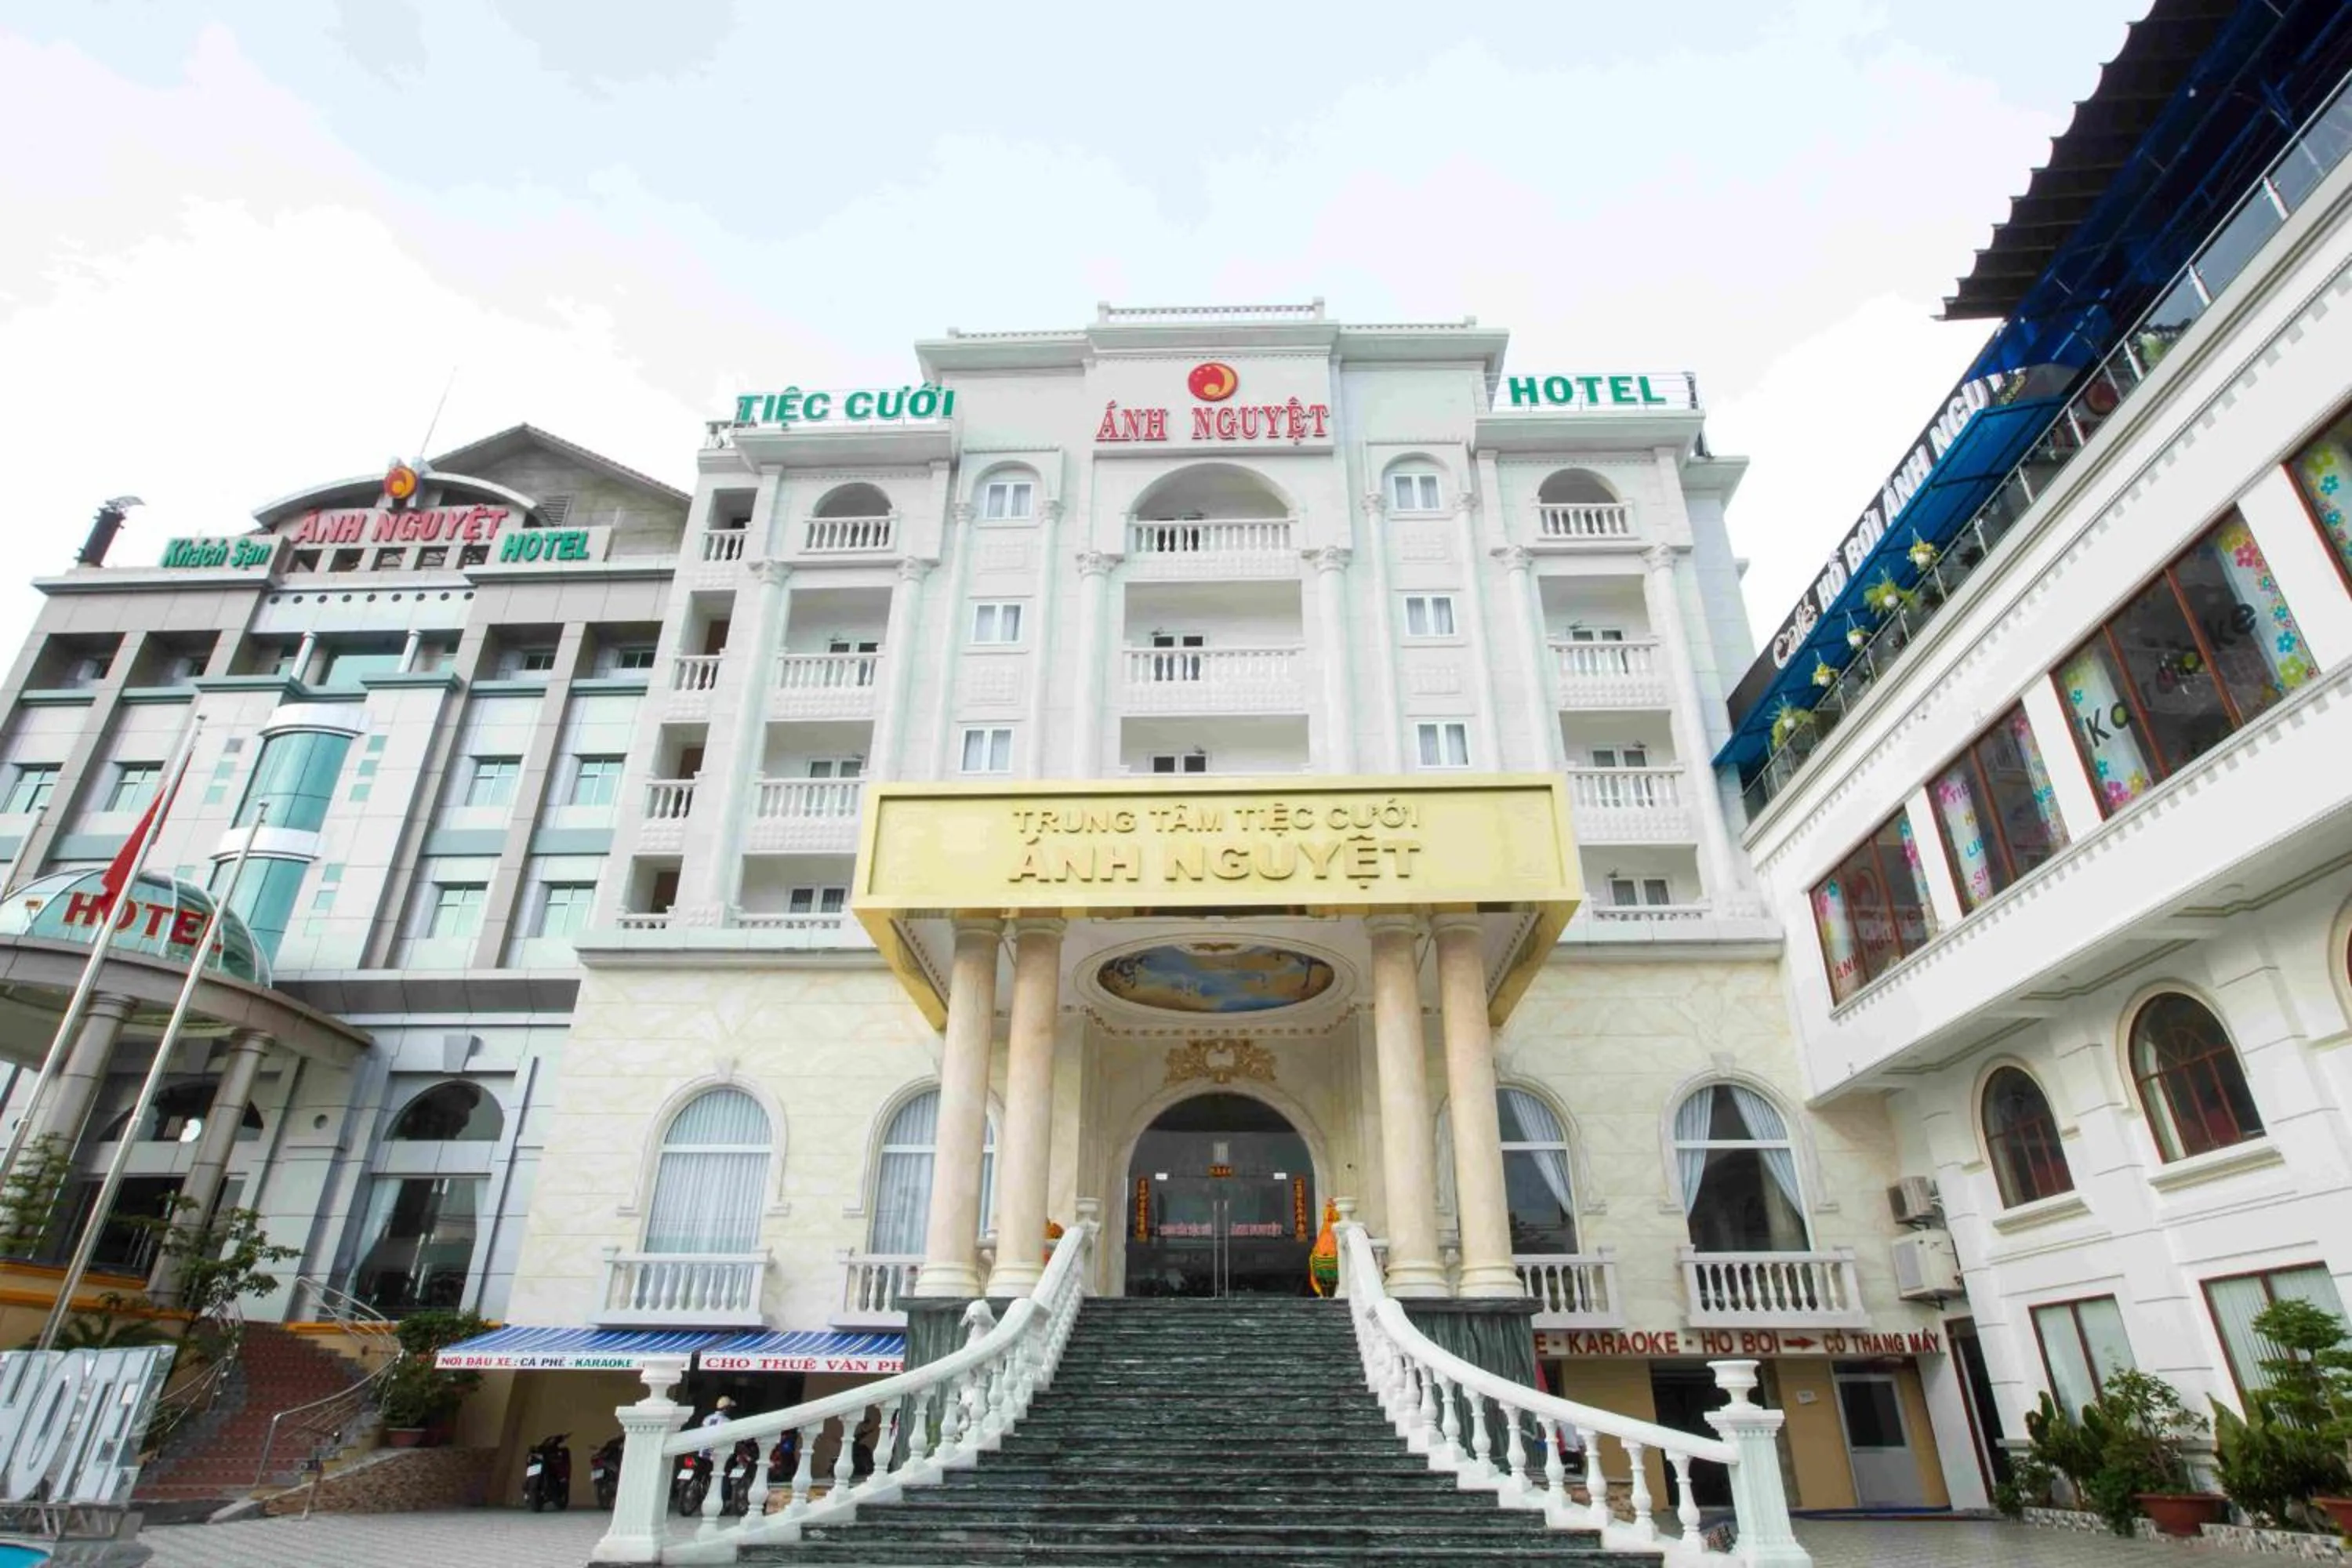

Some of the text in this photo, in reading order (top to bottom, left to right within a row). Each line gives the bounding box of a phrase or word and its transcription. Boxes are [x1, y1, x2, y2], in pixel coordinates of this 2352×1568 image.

[735, 382, 955, 430] TIỆC CƯỚI
[1508, 376, 1667, 406] HOTEL
[1095, 397, 1330, 445] ÁNH NGUYỆT
[293, 503, 510, 547] ÁNH NGUYỆT
[161, 537, 273, 570] Khách Sạn
[499, 529, 590, 563] HOTEL
[1013, 798, 1420, 837] TRUNG TÂM TIỆC CƯỚI
[1008, 835, 1421, 889] ÁNH NGUYỆT
[1569, 1330, 1679, 1355] KARAOKE
[575, 1358, 636, 1368] KARAOKE
[705, 1357, 751, 1369] CHO
